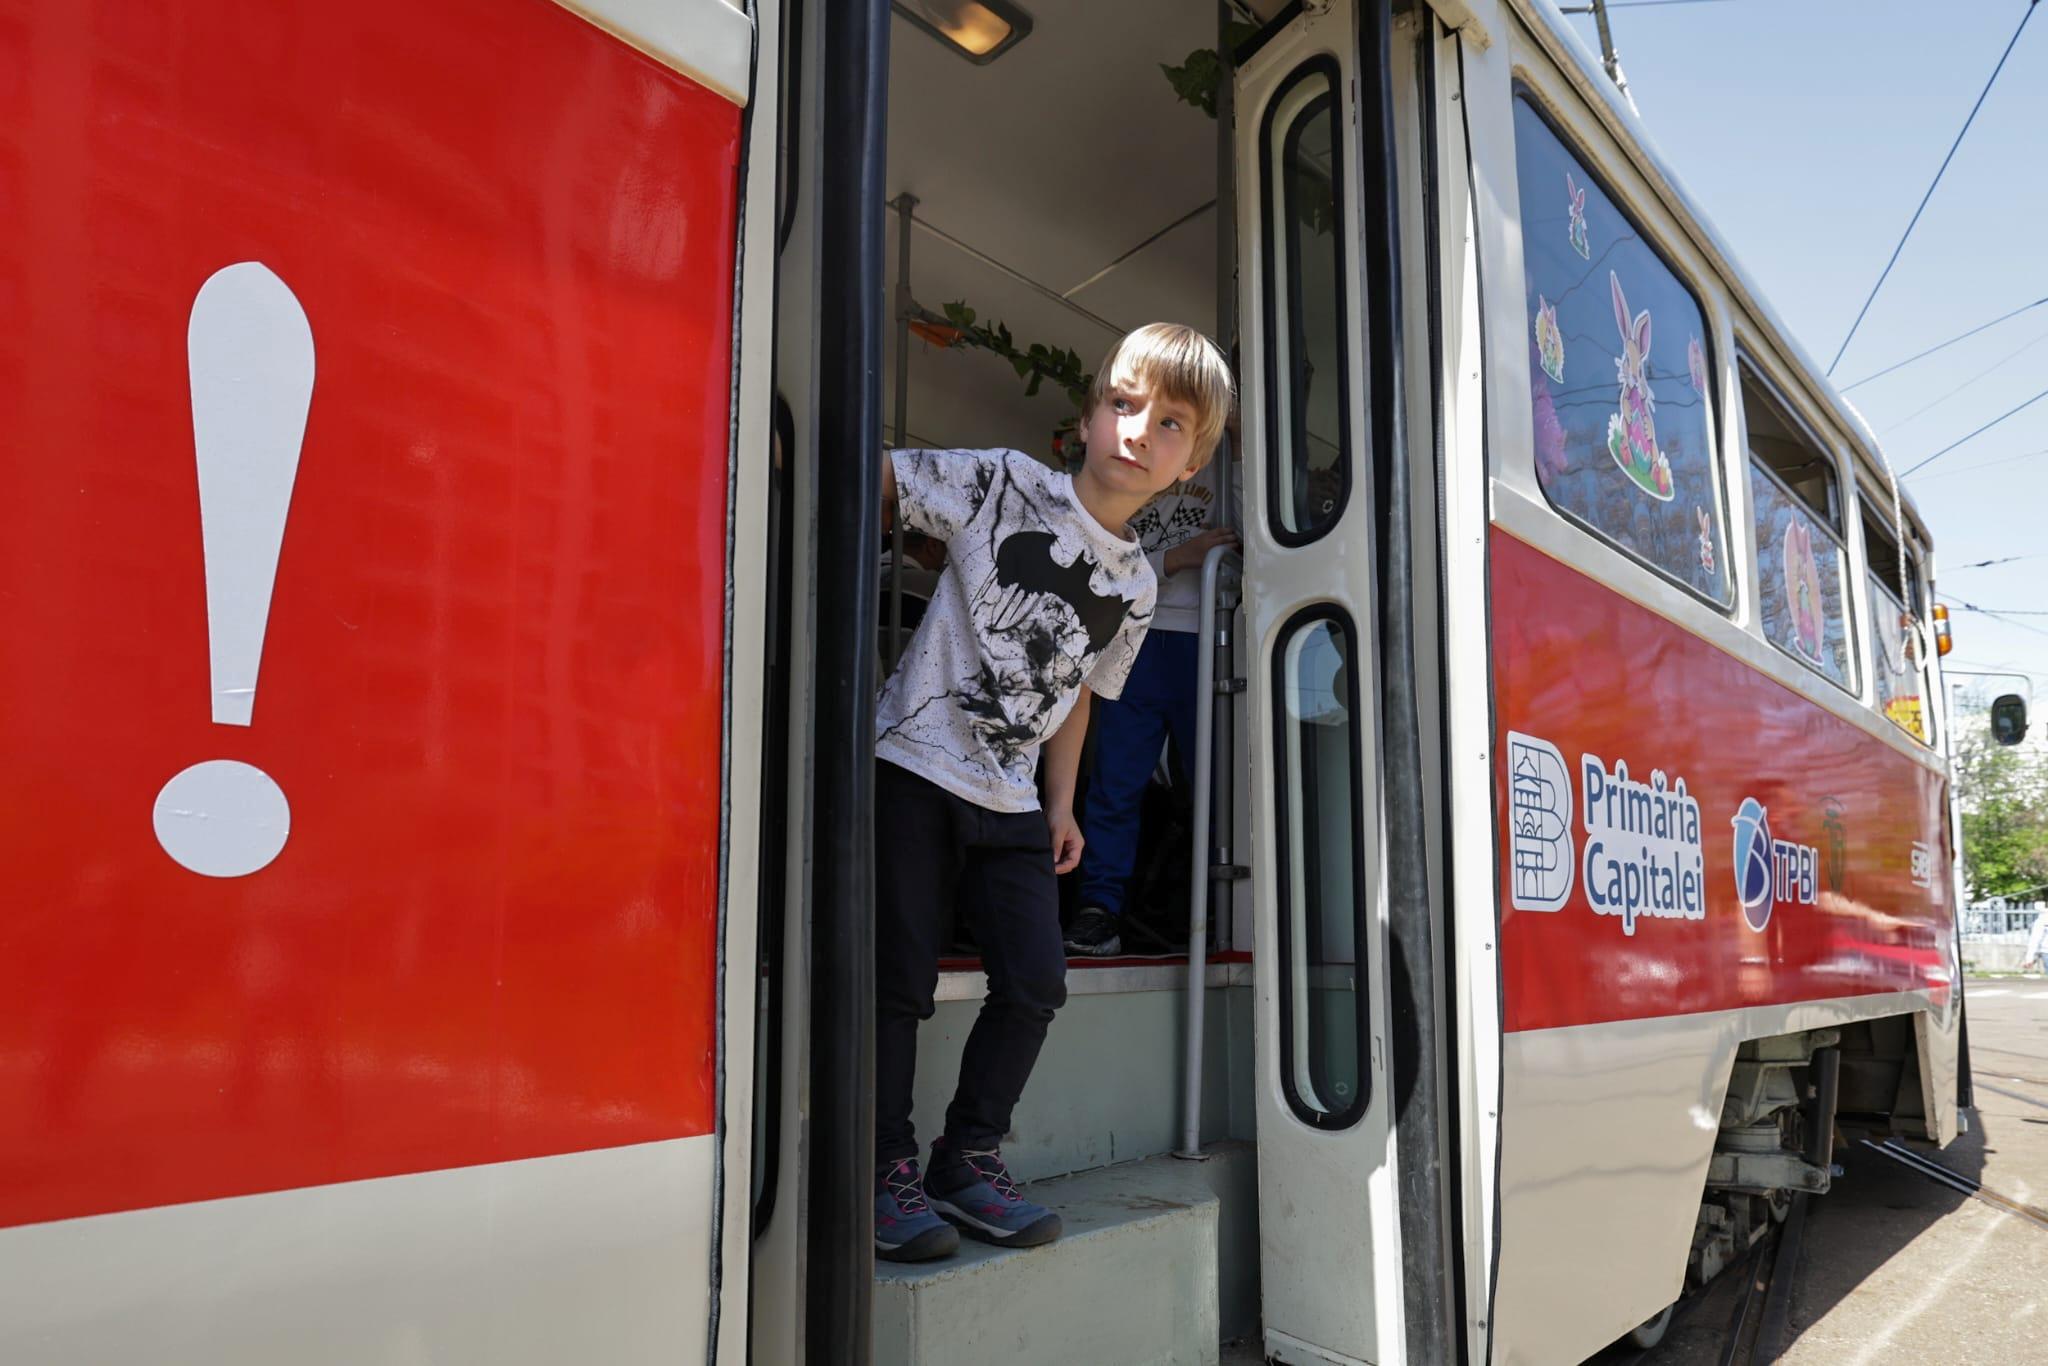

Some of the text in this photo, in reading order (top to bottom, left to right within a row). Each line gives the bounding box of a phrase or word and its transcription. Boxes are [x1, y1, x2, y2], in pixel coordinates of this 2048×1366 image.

[1586, 762, 1699, 845] Primăria
[1587, 841, 1702, 927] Capitalei
[1774, 841, 1819, 905] TPBI
